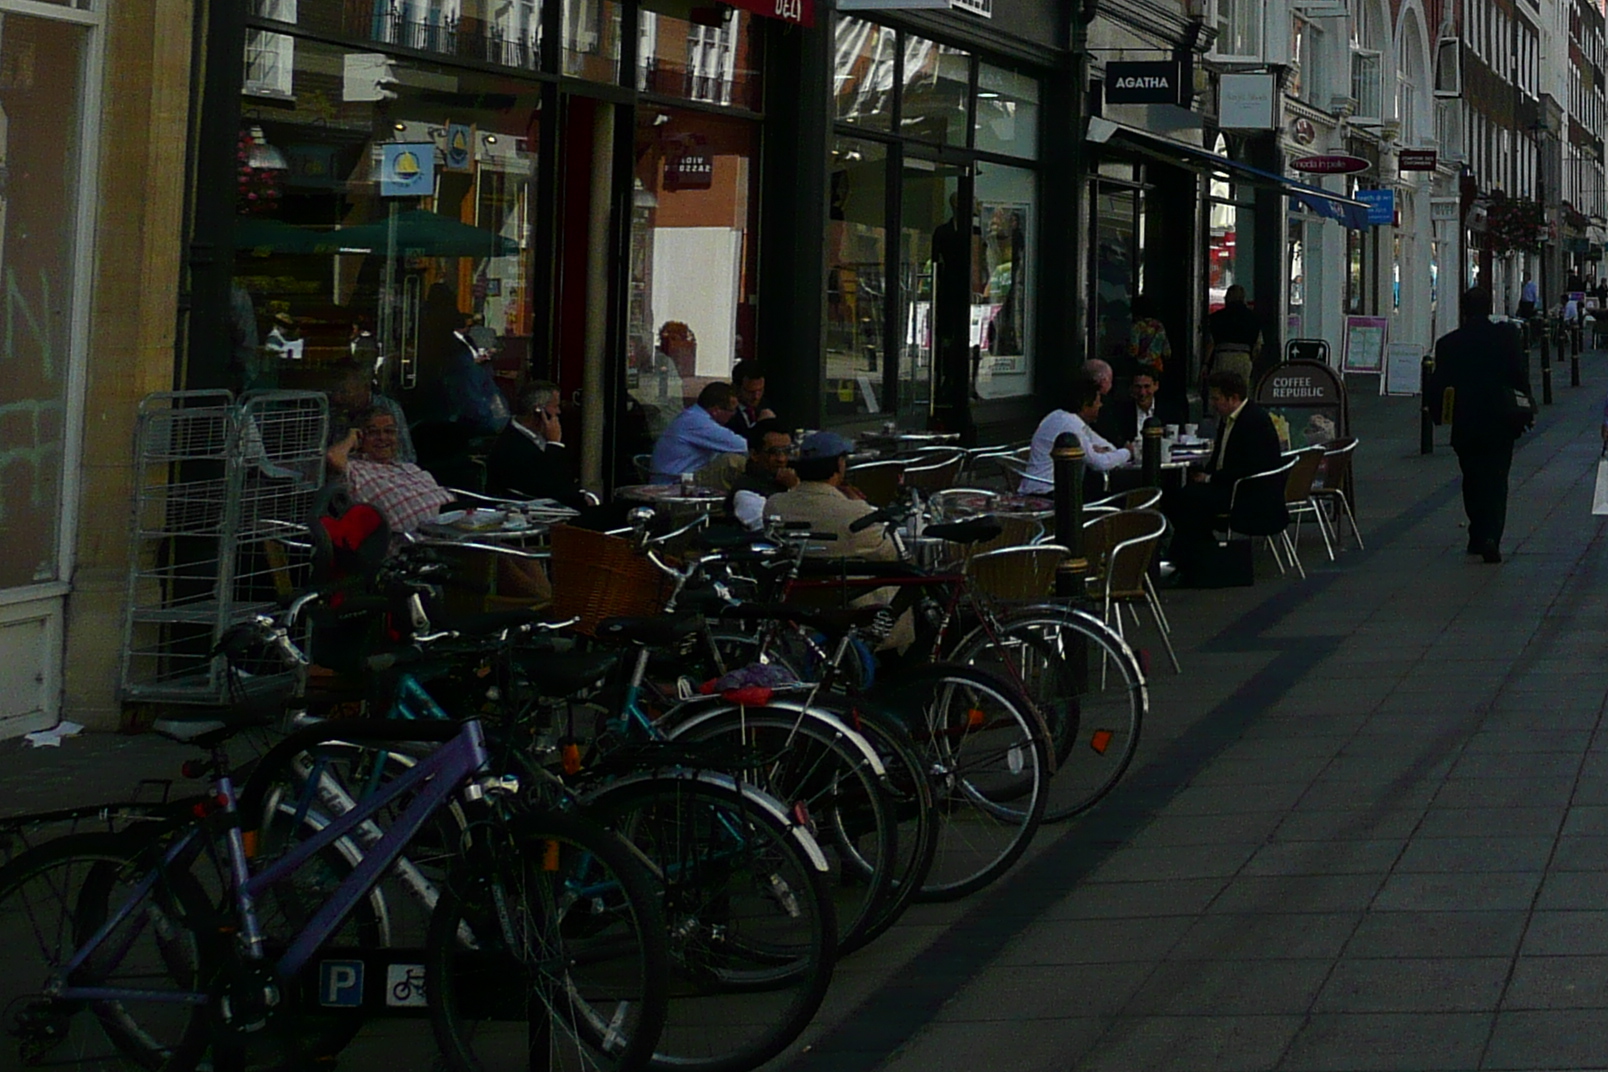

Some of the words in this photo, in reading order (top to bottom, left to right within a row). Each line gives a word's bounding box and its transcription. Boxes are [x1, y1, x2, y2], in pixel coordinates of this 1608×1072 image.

[1115, 77, 1169, 88] AGATHA
[1274, 378, 1311, 387] COFFEE
[1274, 387, 1324, 398] REPUBLIC
[329, 966, 356, 1002] P
